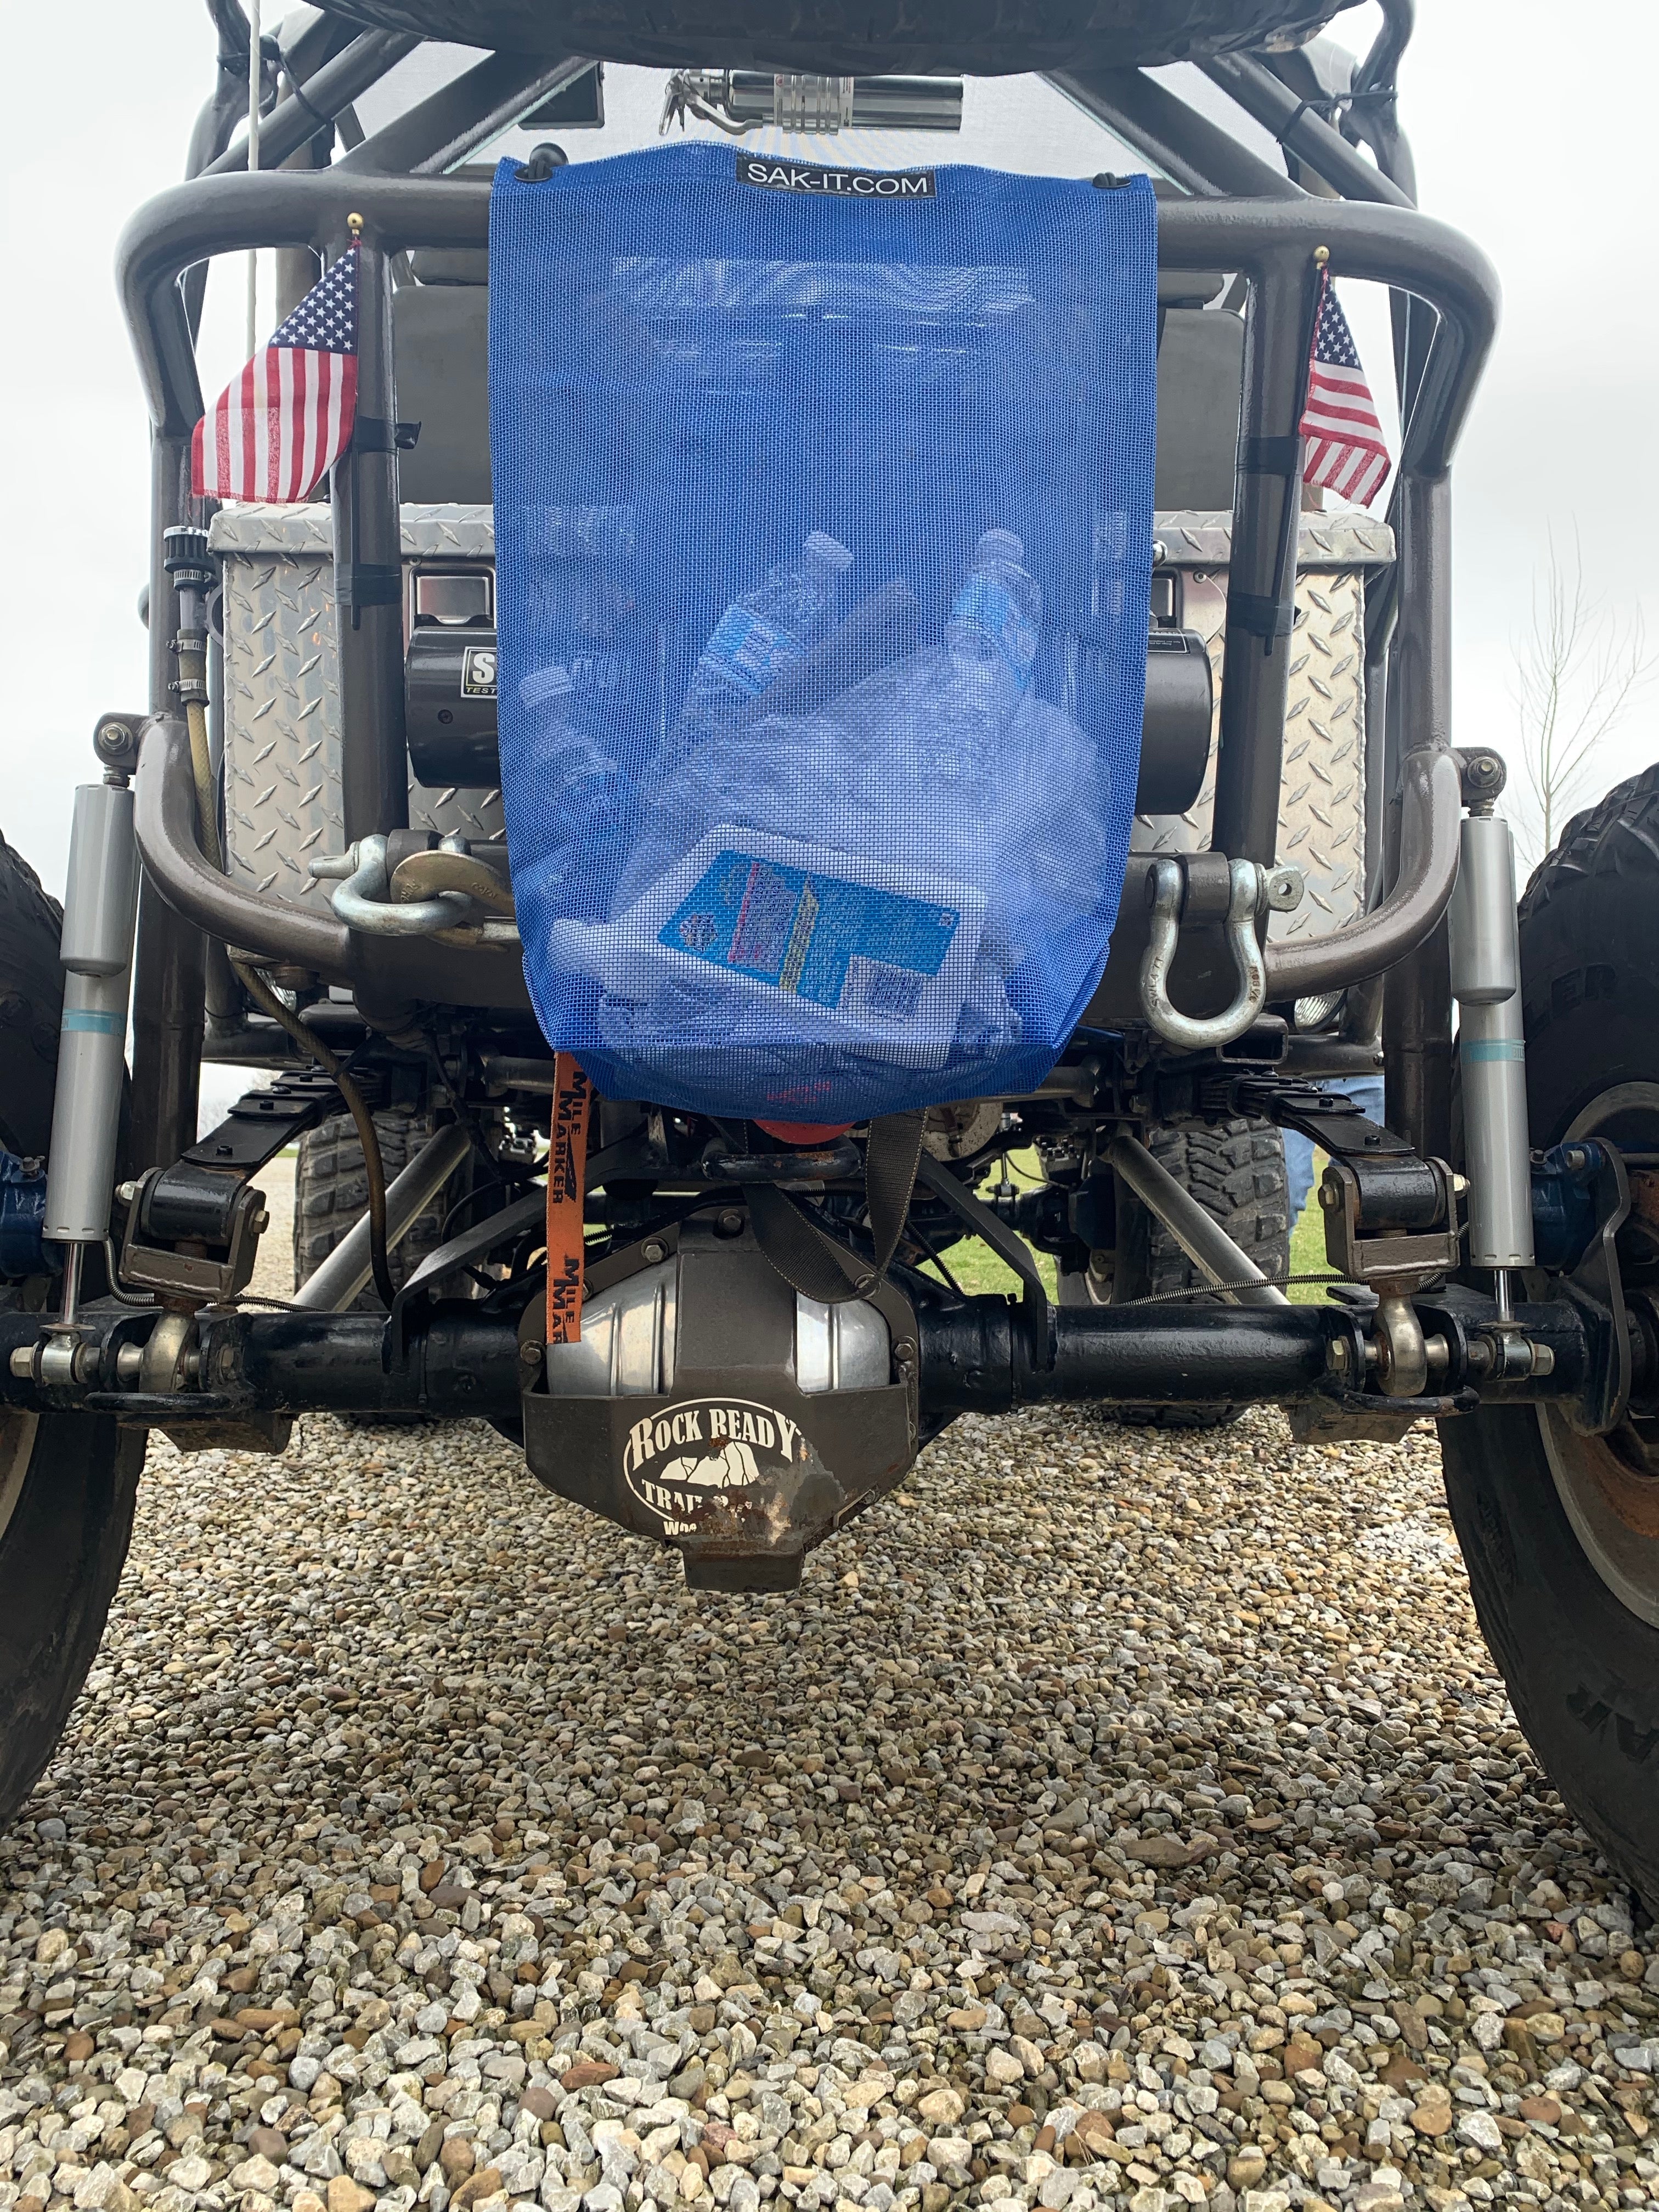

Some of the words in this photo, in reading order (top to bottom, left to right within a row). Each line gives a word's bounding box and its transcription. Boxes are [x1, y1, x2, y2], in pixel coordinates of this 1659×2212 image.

[747, 163, 928, 194] SAK-IT.COM
[571, 1071, 589, 1135] MILE
[553, 1091, 572, 1204] MARKER
[565, 1258, 580, 1323] MILE
[629, 1410, 703, 1471] ROCK
[709, 1408, 797, 1463] READY
